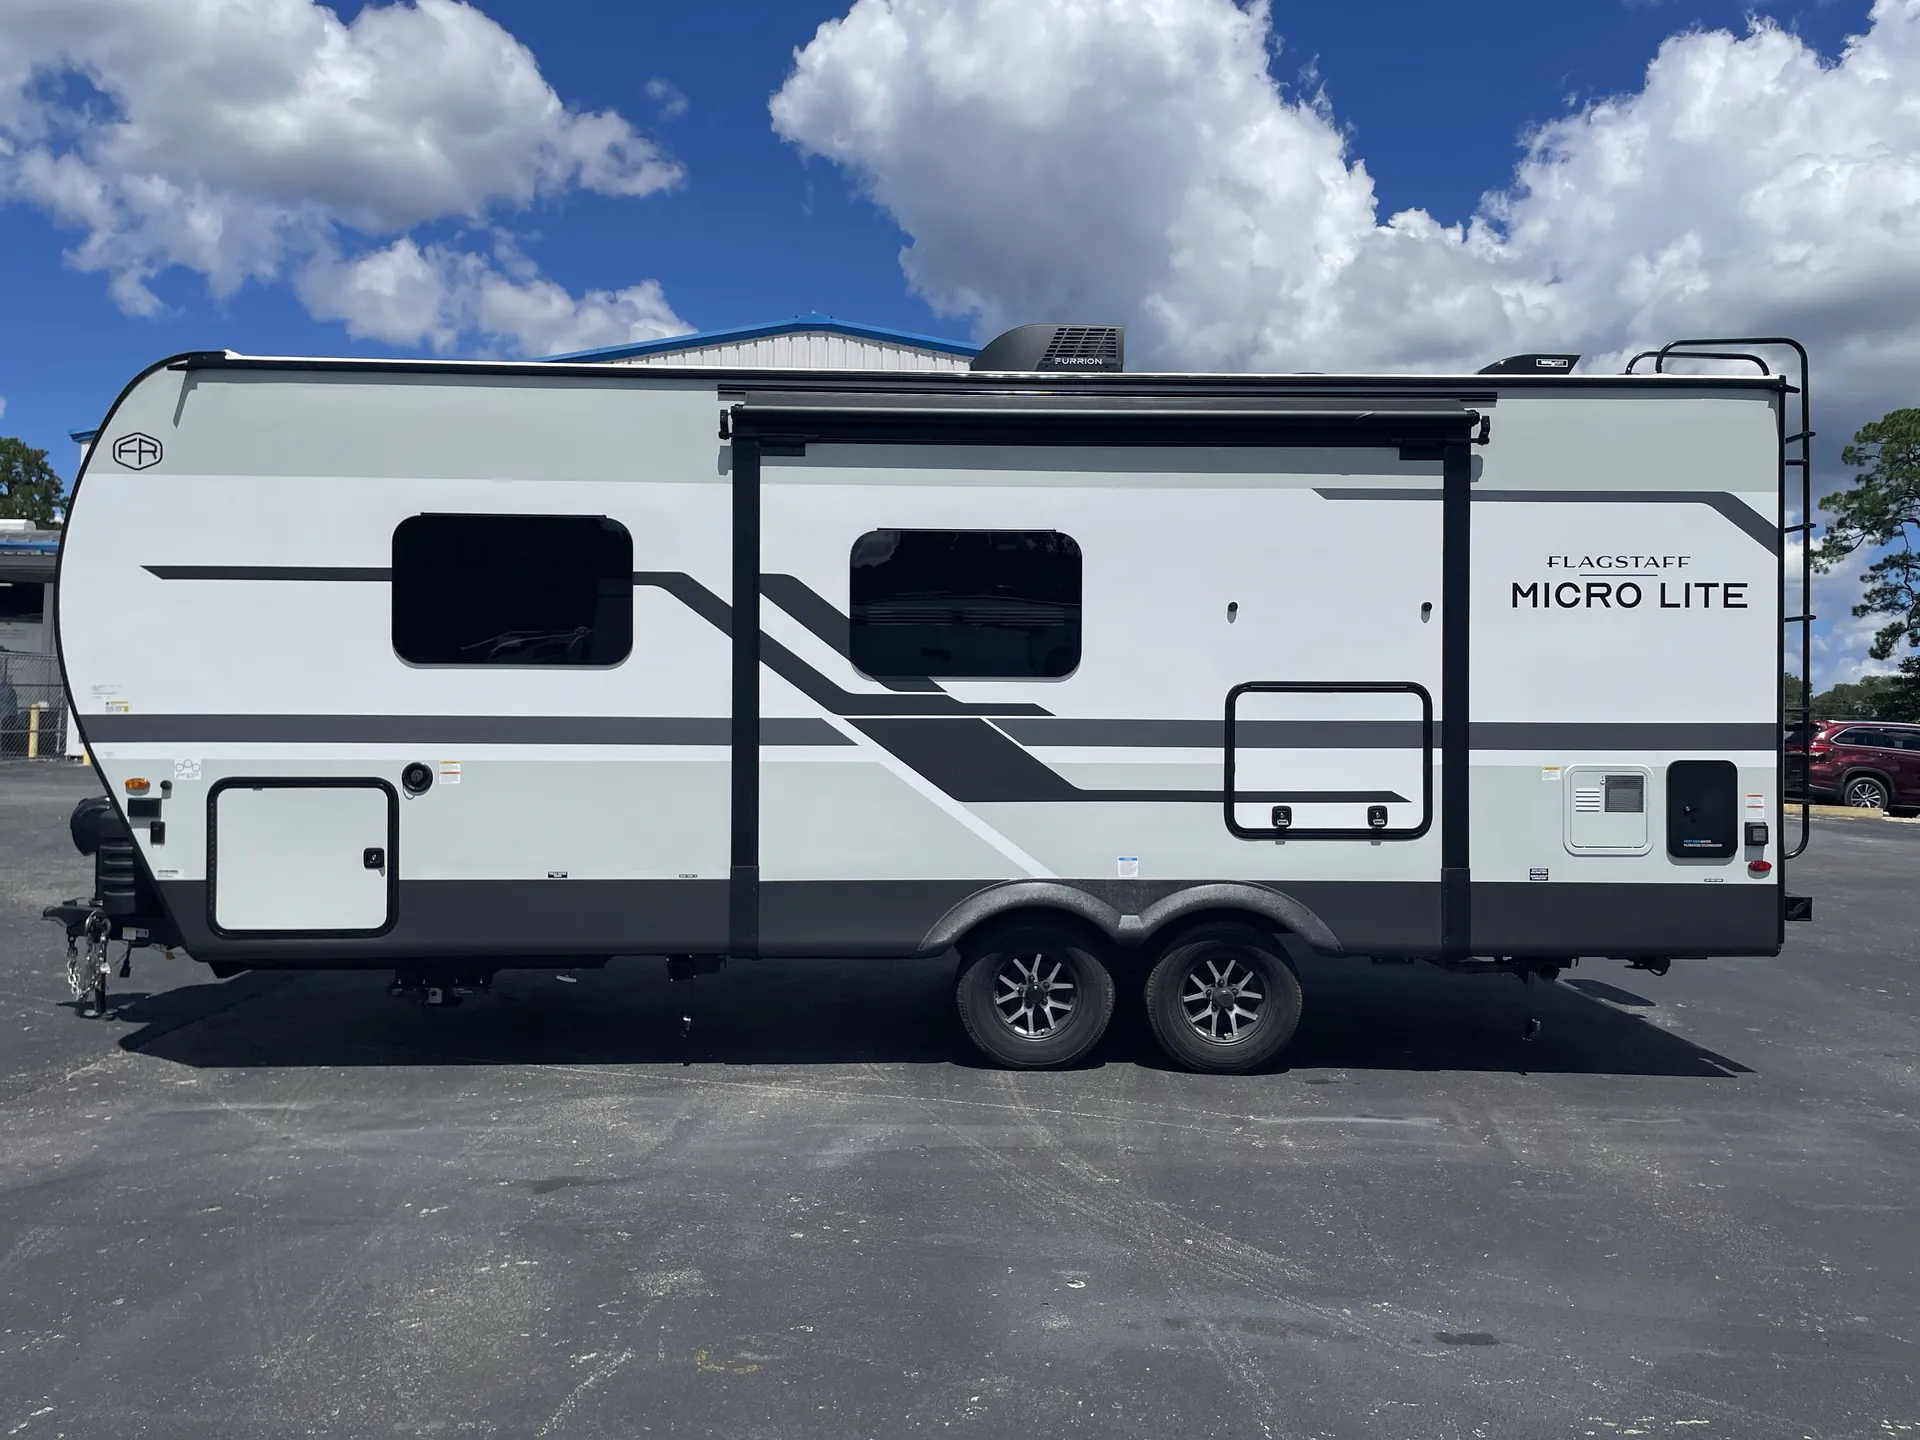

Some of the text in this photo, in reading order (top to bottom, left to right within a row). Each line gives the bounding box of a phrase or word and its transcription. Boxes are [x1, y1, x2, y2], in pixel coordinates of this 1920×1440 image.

[1054, 357, 1103, 365] FURRION
[118, 437, 158, 465] FR
[1546, 555, 1691, 569] FLAGSTAFF
[1511, 581, 1748, 609] MICRO LITE
